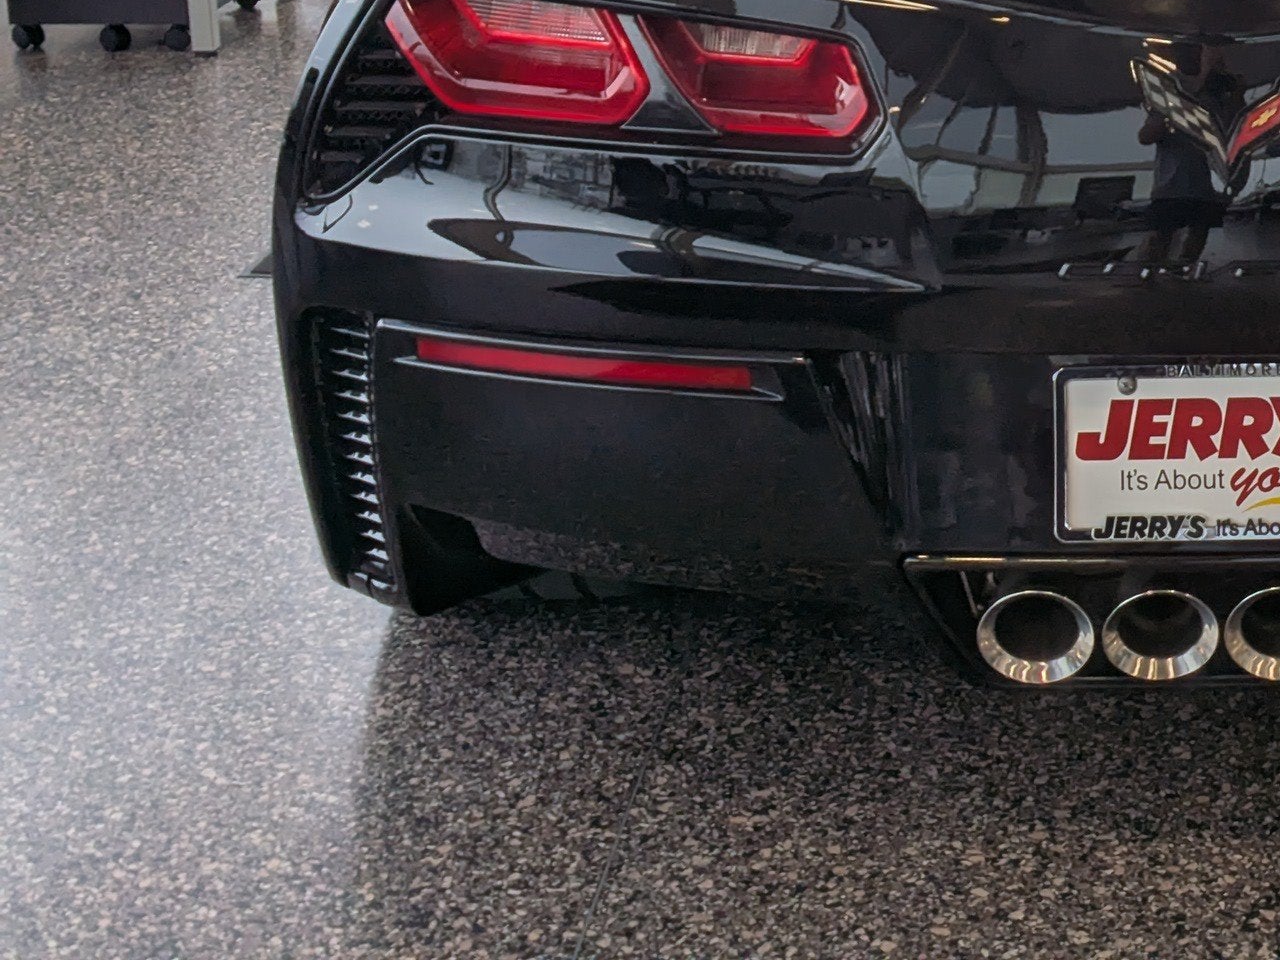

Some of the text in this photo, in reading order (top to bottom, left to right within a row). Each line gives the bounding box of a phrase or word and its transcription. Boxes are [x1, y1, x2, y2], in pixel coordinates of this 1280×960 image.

[1120, 469, 1149, 491] It's
[1154, 469, 1225, 491] About
[1093, 515, 1207, 539] JERRY'S
[1216, 519, 1239, 536] It's
